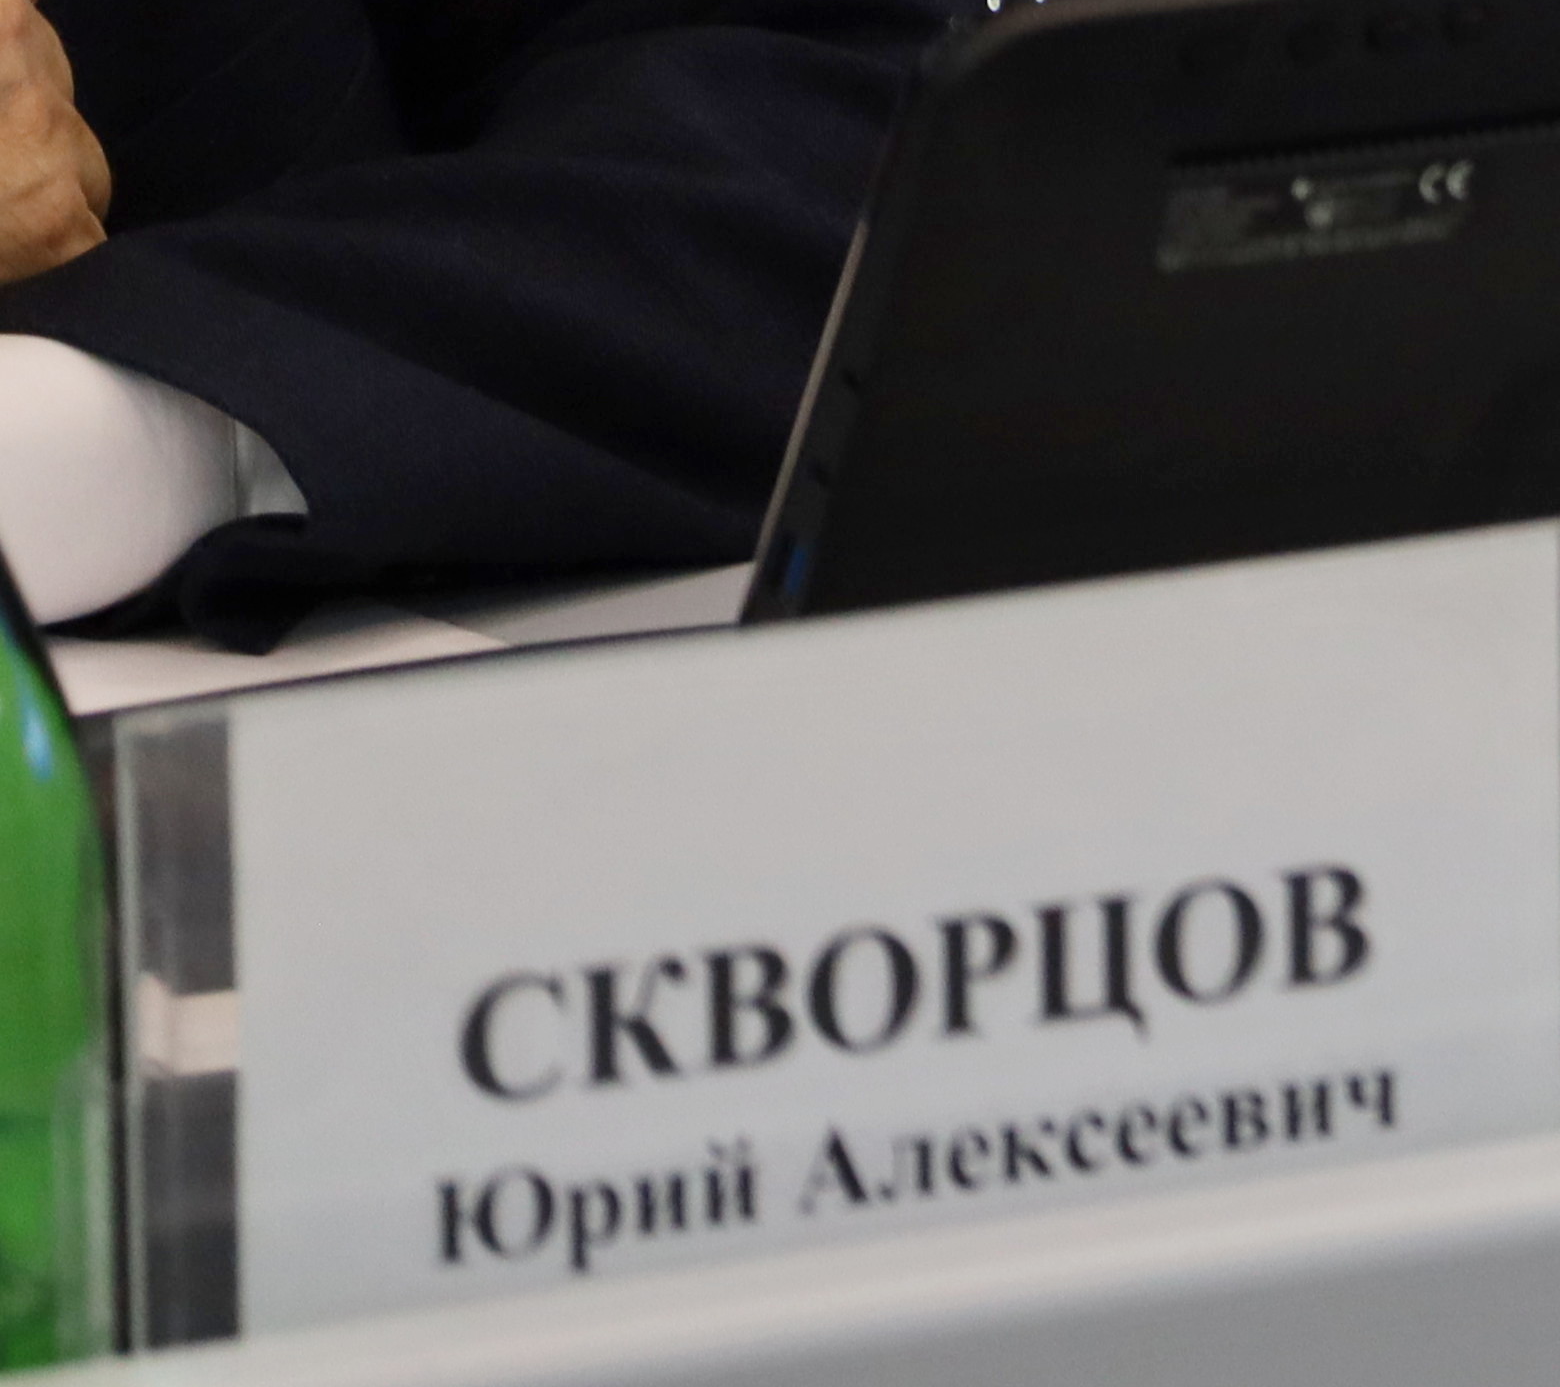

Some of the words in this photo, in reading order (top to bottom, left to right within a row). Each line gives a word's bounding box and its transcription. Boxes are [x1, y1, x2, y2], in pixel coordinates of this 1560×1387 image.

[458, 862, 1373, 1103] СКВОРЦОВ
[435, 1139, 760, 1275] Юрий
[800, 1067, 1399, 1212] Алексеевич
